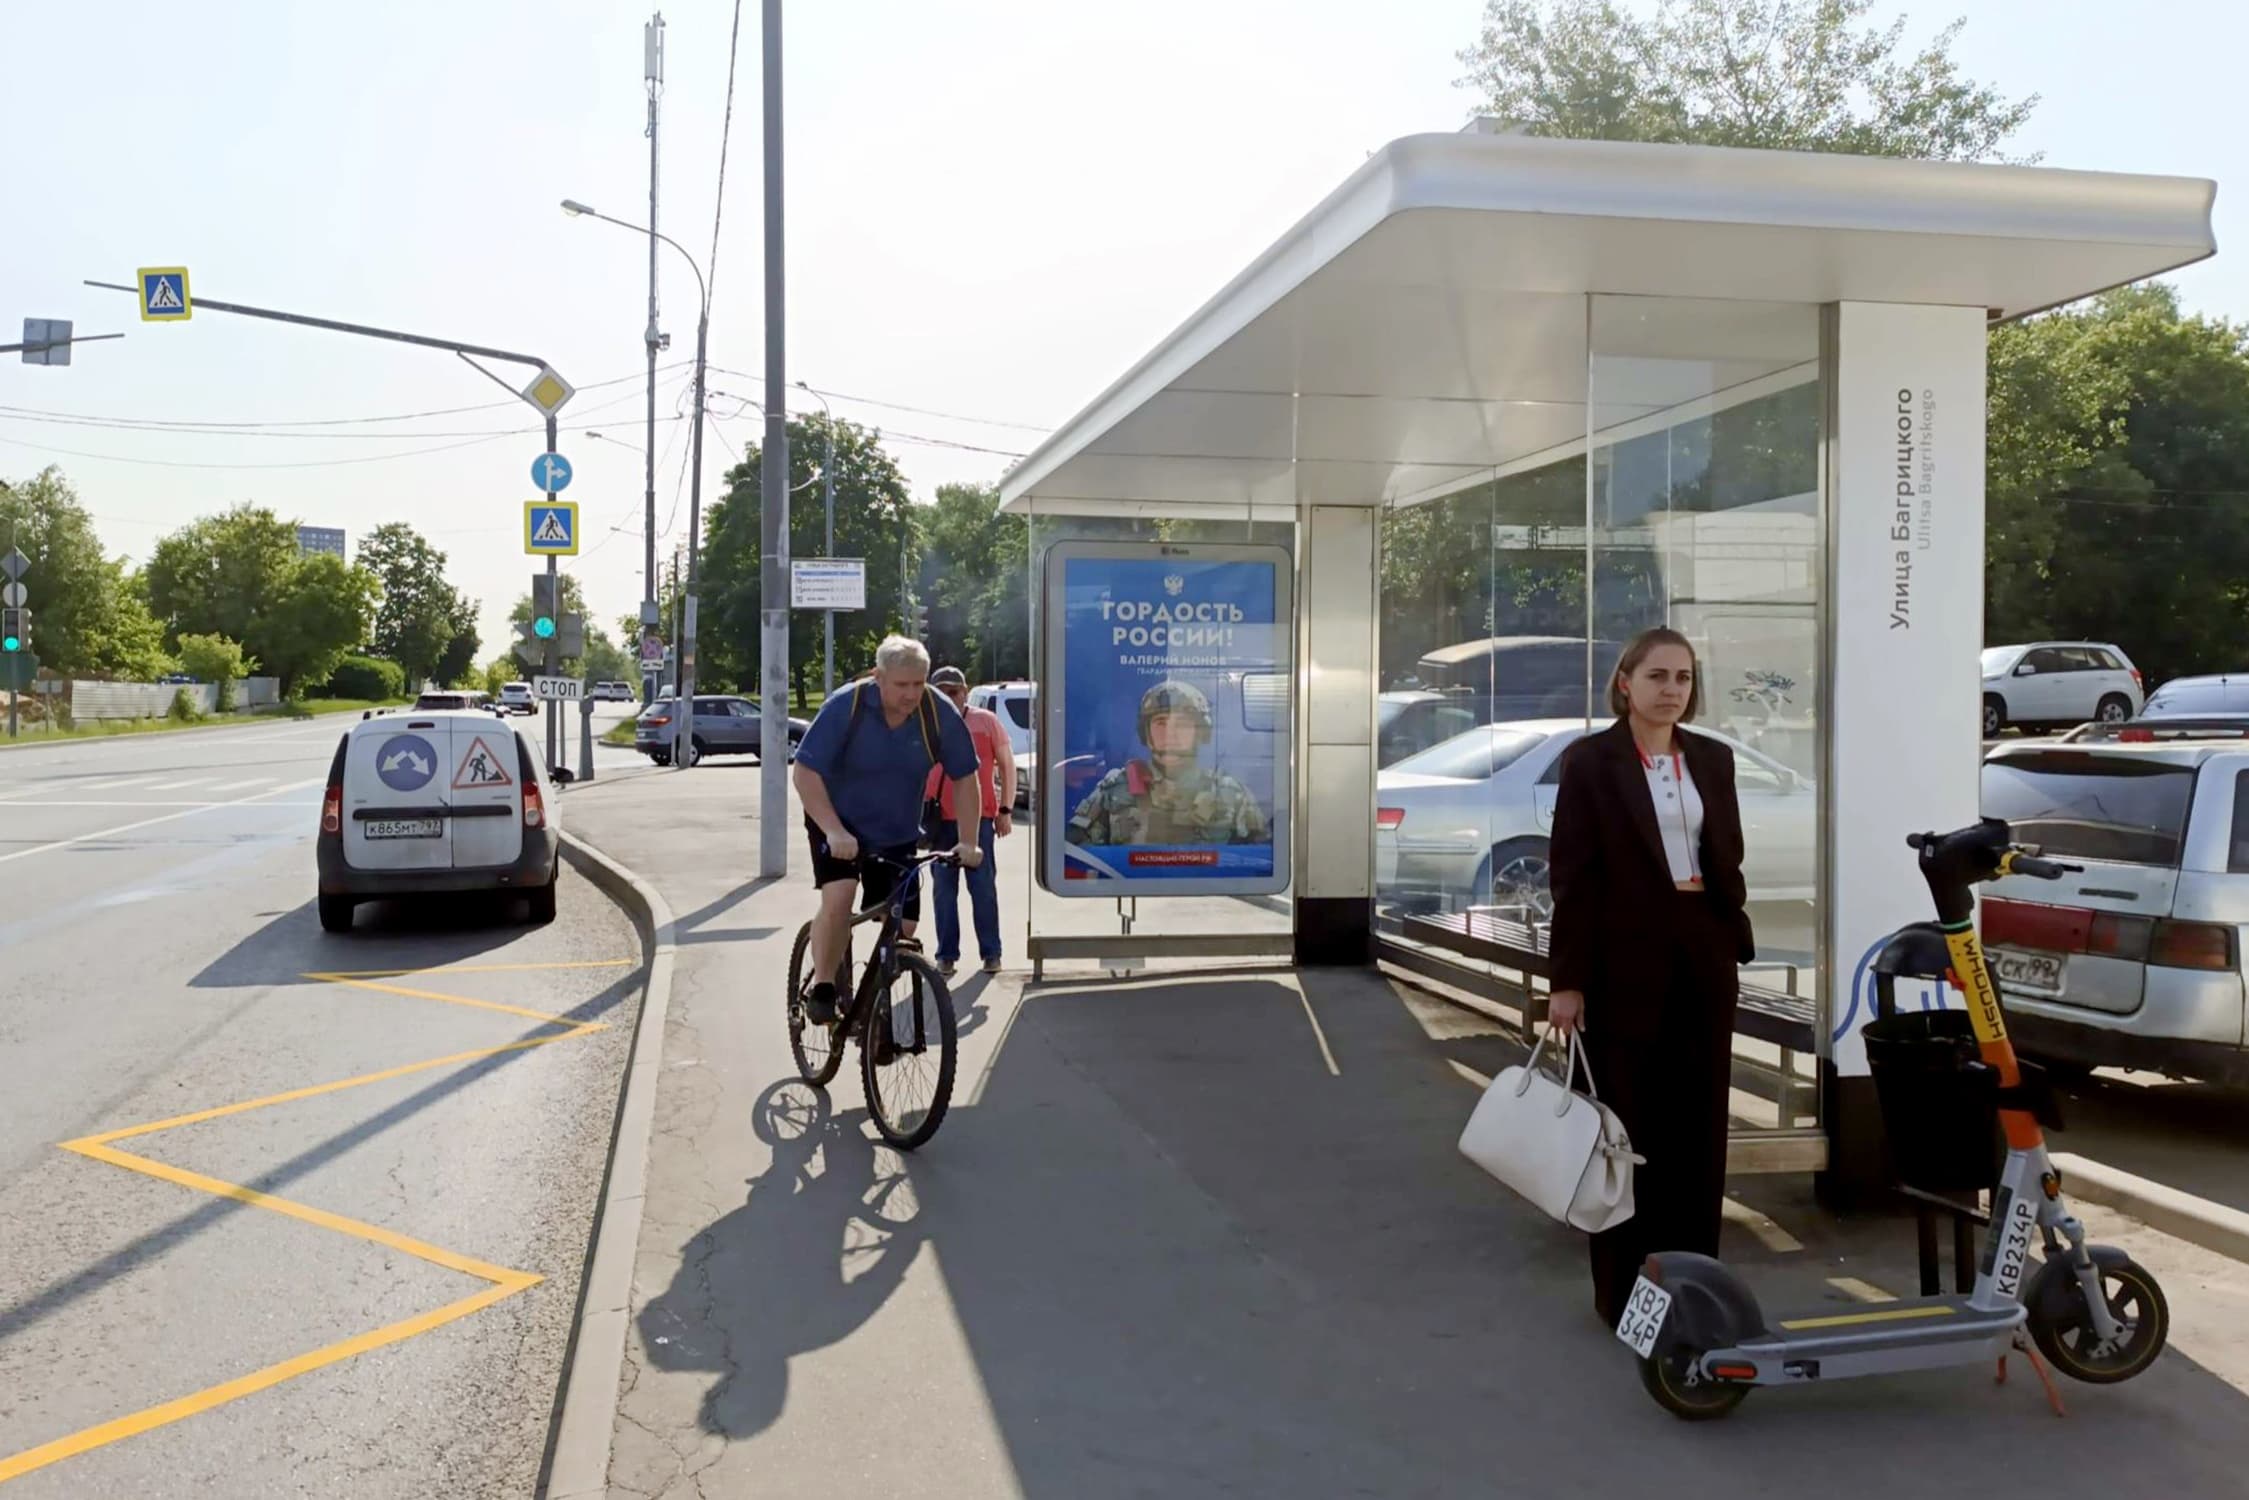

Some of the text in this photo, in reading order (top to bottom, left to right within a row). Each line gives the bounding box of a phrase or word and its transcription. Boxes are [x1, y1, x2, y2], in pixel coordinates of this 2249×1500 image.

[1917, 388, 1936, 550] Ulitsa Bagritskogo
[1889, 388, 1915, 630] Улица Багрицкого
[1102, 601, 1244, 623] ГОРДОСТЬ
[1112, 627, 1233, 646] РОССИИ!
[1119, 654, 1178, 666] ВАЛЕРИЙ
[539, 680, 577, 697] СТОП
[1963, 938, 2003, 1040] WHOOSH
